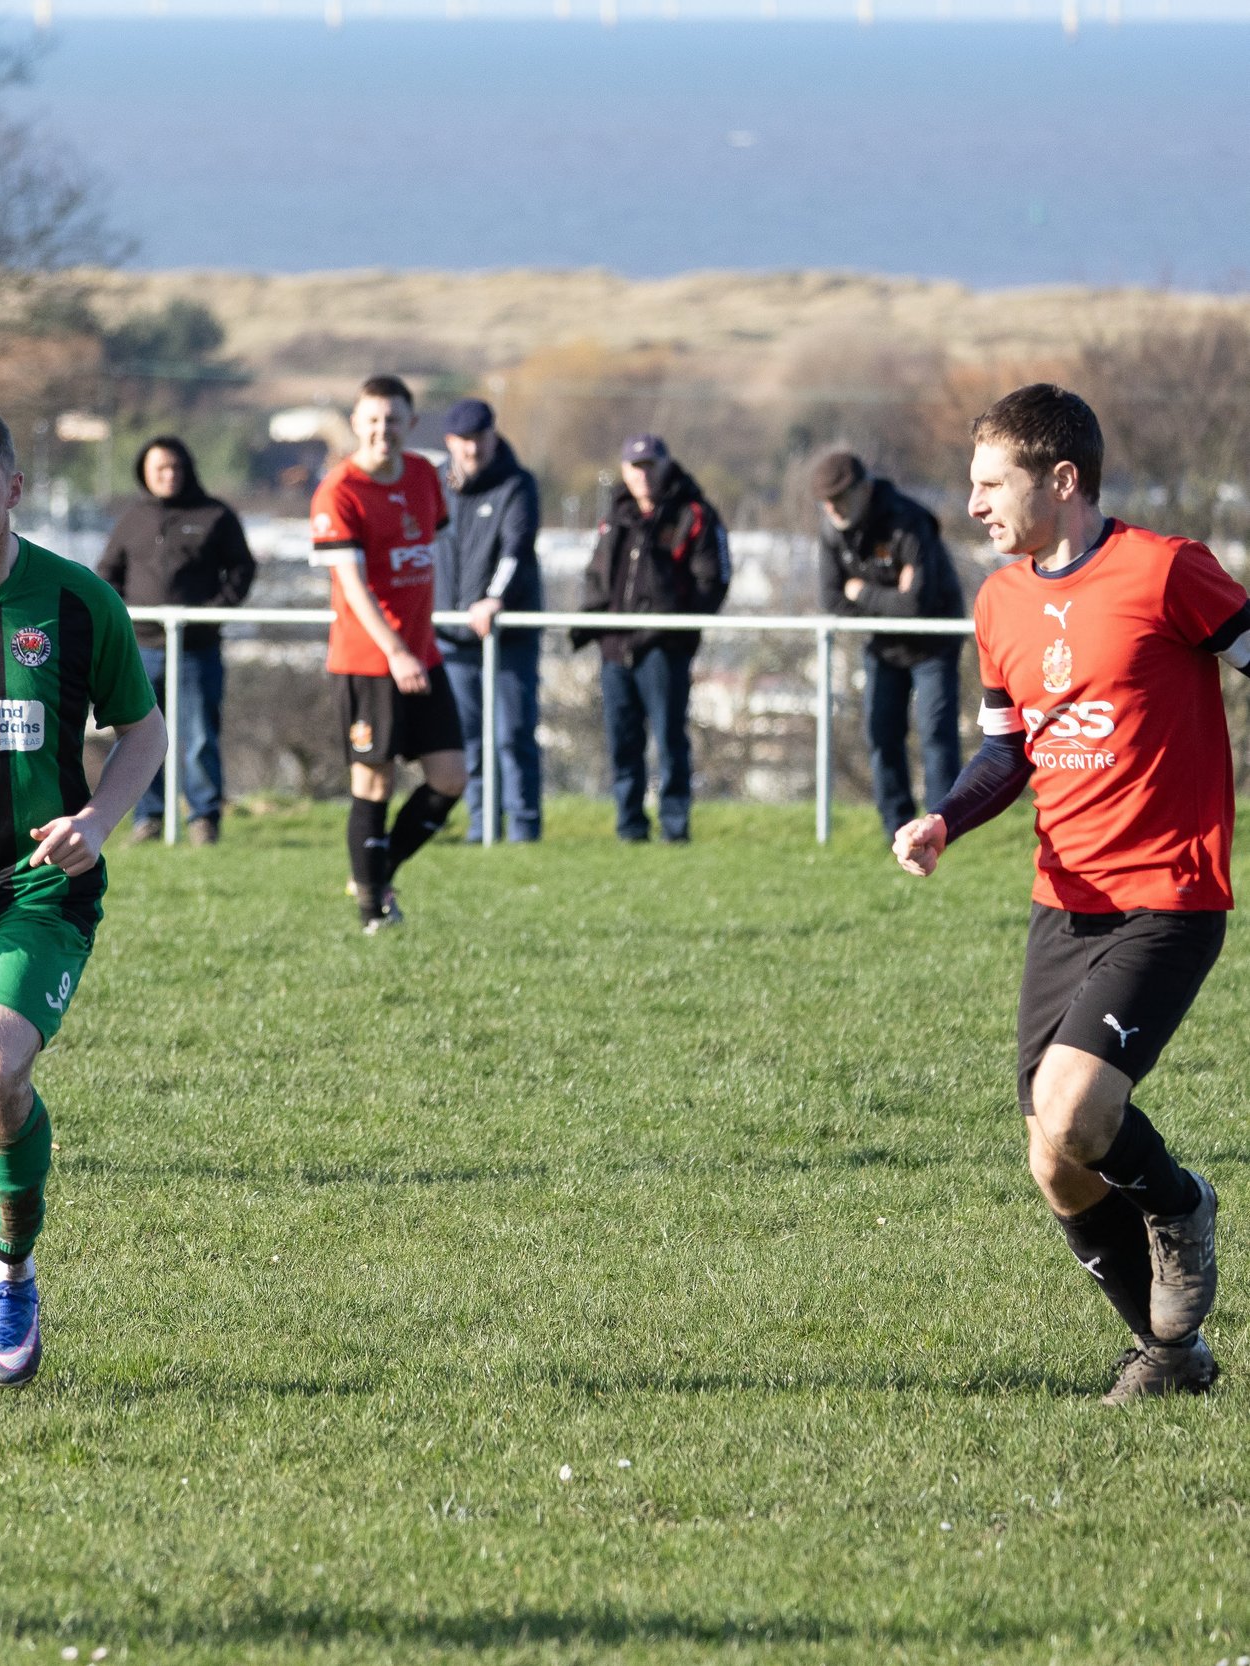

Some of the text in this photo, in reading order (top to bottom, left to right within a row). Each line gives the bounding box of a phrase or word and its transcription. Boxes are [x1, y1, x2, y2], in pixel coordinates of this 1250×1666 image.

[1022, 701, 1115, 743] PSS
[1059, 752, 1116, 769] CENTRE
[58, 971, 70, 1000] 9
